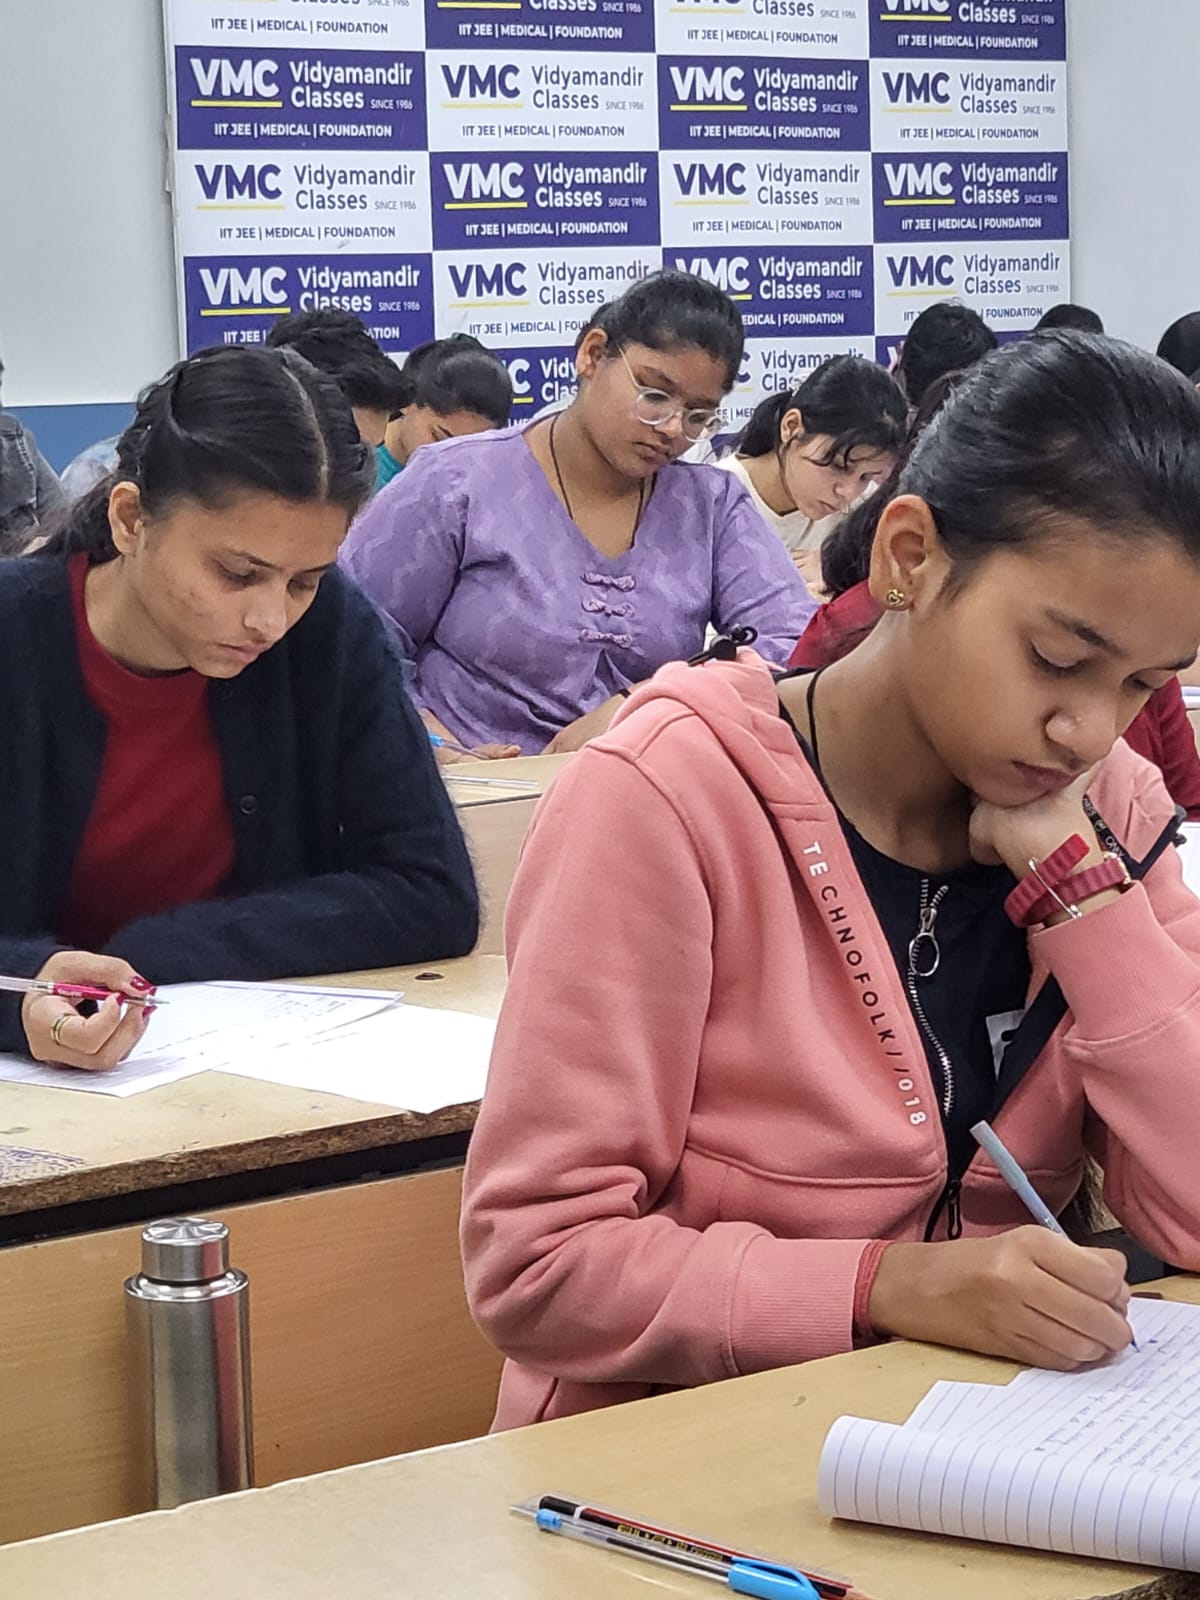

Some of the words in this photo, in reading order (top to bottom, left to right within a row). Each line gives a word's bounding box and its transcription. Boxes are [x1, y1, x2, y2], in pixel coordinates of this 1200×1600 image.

[603, 2, 624, 12] SINCE
[753, 0, 814, 17] Classes
[820, 9, 839, 18] SINCE
[959, 3, 1016, 23] Classes
[1021, 15, 1039, 24] SINCE
[211, 18, 224, 29] IIT
[228, 19, 247, 29] JEE
[257, 20, 307, 31] MEDICAL
[317, 21, 387, 33] FOUNDATION
[459, 24, 472, 35] IIT
[474, 24, 492, 35] JEE
[501, 24, 547, 36] MEDICAL
[555, 26, 622, 38] FOUNDATION
[688, 30, 699, 40] IIT
[702, 30, 718, 39] JEE
[727, 30, 769, 41] MEDICAL
[777, 32, 837, 43] FOUNDATION
[898, 35, 909, 45] IIT
[911, 35, 927, 46] JEE
[934, 35, 974, 46] MEDICAL
[980, 36, 1037, 48] FOUNDATION
[190, 59, 279, 97] VMC
[290, 60, 412, 88] Vidyamandir
[441, 64, 520, 98] VMC
[532, 65, 643, 90] Vidyamandir
[670, 67, 744, 101] VMC
[754, 68, 858, 93] Vidyamandir
[883, 72, 950, 103] VMC
[960, 73, 1056, 96] Vidyamandir
[291, 86, 364, 108] Classes
[371, 99, 393, 109] SINCE
[533, 89, 598, 109] Classes
[606, 101, 626, 110] SINCE
[755, 91, 816, 112] Classes
[822, 104, 842, 113] SINCE
[961, 96, 1017, 113] Classes
[1023, 106, 1040, 114] SINCE
[215, 123, 228, 135] IIT
[231, 123, 251, 135] JEE
[260, 124, 311, 135] MEDICAL
[319, 124, 391, 136] FOUNDATION
[462, 126, 475, 136] IIT
[478, 125, 495, 136] JEE
[504, 126, 550, 135] MEDICAL
[559, 126, 624, 136] FOUNDATION
[690, 126, 702, 136] IIT
[704, 126, 721, 136] JEE
[728, 126, 771, 137] MEDICAL
[779, 126, 840, 138] FOUNDATION
[900, 129, 911, 138] IIT
[913, 129, 928, 138] JEE
[936, 128, 975, 138] MEDICAL
[982, 129, 1038, 138] FOUNDATION
[195, 164, 282, 199] VMC
[294, 164, 415, 189] Vidyamandir
[443, 162, 524, 198] VMC
[534, 163, 647, 188] Vidyamandir
[673, 163, 746, 195] VMC
[757, 163, 860, 187] Vidyamandir
[884, 162, 952, 195] VMC
[961, 163, 1057, 186] Vidyamandir
[296, 190, 367, 209] Classes
[375, 201, 397, 210] SINCE
[536, 187, 602, 207] Classes
[608, 198, 629, 207] SINCE
[758, 186, 818, 205] Classes
[825, 197, 844, 205] SINCE
[962, 185, 1019, 204] Classes
[1024, 195, 1042, 204] SINCE
[220, 228, 233, 238] IIT
[236, 228, 255, 238] JEE
[265, 227, 315, 238] MEDICAL
[324, 227, 395, 237] FOUNDATION
[466, 224, 479, 235] IIT
[481, 224, 499, 235] JEE
[508, 223, 553, 234] MEDICAL
[561, 222, 627, 233] FOUNDATION
[693, 221, 704, 231] IIT
[707, 221, 723, 231] JEE
[731, 221, 774, 230] MEDICAL
[781, 221, 842, 230] FOUNDATION
[902, 219, 913, 229] IIT
[915, 219, 931, 229] JEE
[938, 218, 977, 229] MEDICAL
[984, 218, 1041, 228] FOUNDATION
[759, 256, 862, 281] Vidyamandir
[887, 255, 954, 286] VMC
[964, 252, 1060, 276] Vidyamandir
[200, 267, 287, 305] VMC
[298, 265, 420, 291] Vidyamandir
[448, 263, 527, 297] VMC
[965, 276, 1021, 294] Classes
[1026, 285, 1044, 293] SINCE
[539, 286, 606, 305] Classes
[760, 279, 821, 299] Classes
[827, 290, 845, 299] SINCE
[379, 301, 401, 311] SINCE
[904, 311, 914, 321] IIT
[986, 308, 1043, 319] FOUNDATION
[469, 324, 482, 336] IIT
[484, 323, 502, 334] JEE
[511, 322, 556, 332] MEDICAL
[741, 313, 776, 326] EDICAL
[783, 313, 844, 324] FOUNDATION
[224, 332, 238, 343] IIT
[240, 331, 260, 343] JEE
